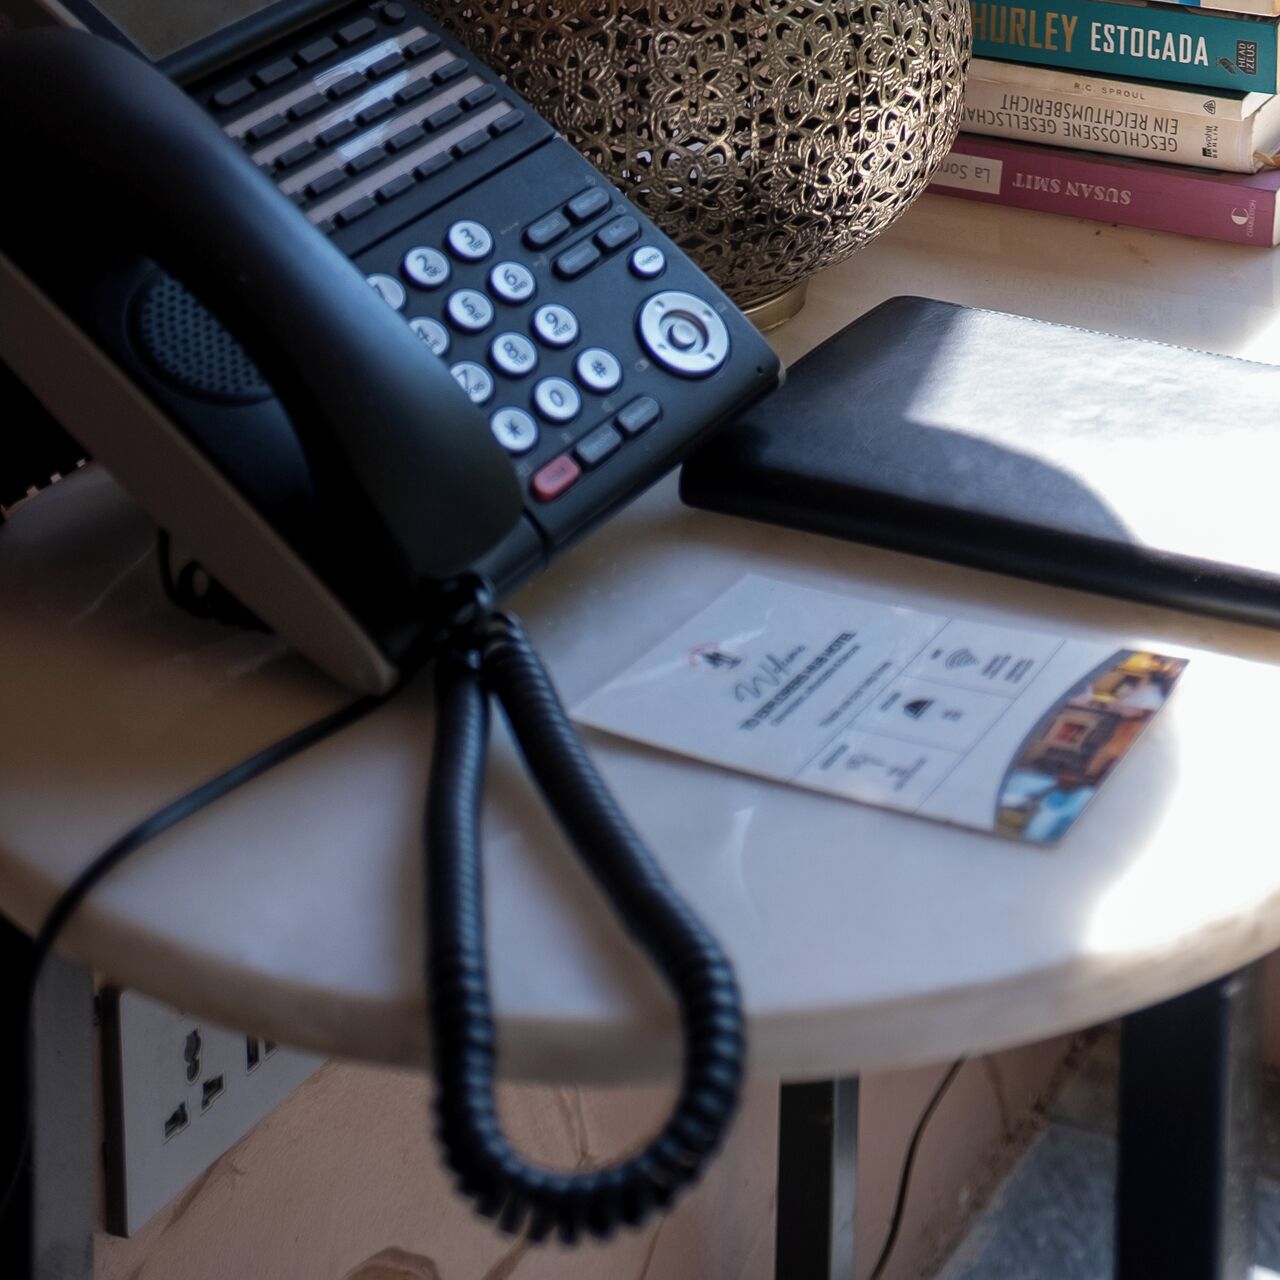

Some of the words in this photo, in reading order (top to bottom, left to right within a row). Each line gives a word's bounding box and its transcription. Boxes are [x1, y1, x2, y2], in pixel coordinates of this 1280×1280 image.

[970, 1, 1079, 53] HURLEY
[1090, 21, 1209, 67] ESTOCADA
[1237, 42, 1246, 69] HEAD
[1245, 43, 1256, 71] ZEUS
[1101, 86, 1146, 101] SPROUL
[1000, 93, 1149, 131] REICHTUMSBERICHT
[1154, 117, 1179, 134] EIN
[1063, 121, 1179, 153] GESCHLOSSENE
[974, 166, 991, 184] La
[1012, 172, 1062, 194] SMIT
[1065, 180, 1132, 206] SUSAN
[460, 228, 475, 245] 3
[416, 254, 427, 273] 2
[504, 268, 518, 286] 6
[461, 297, 476, 315] 5
[545, 312, 559, 330] 9
[503, 341, 519, 360] 8
[550, 389, 565, 408] 0
